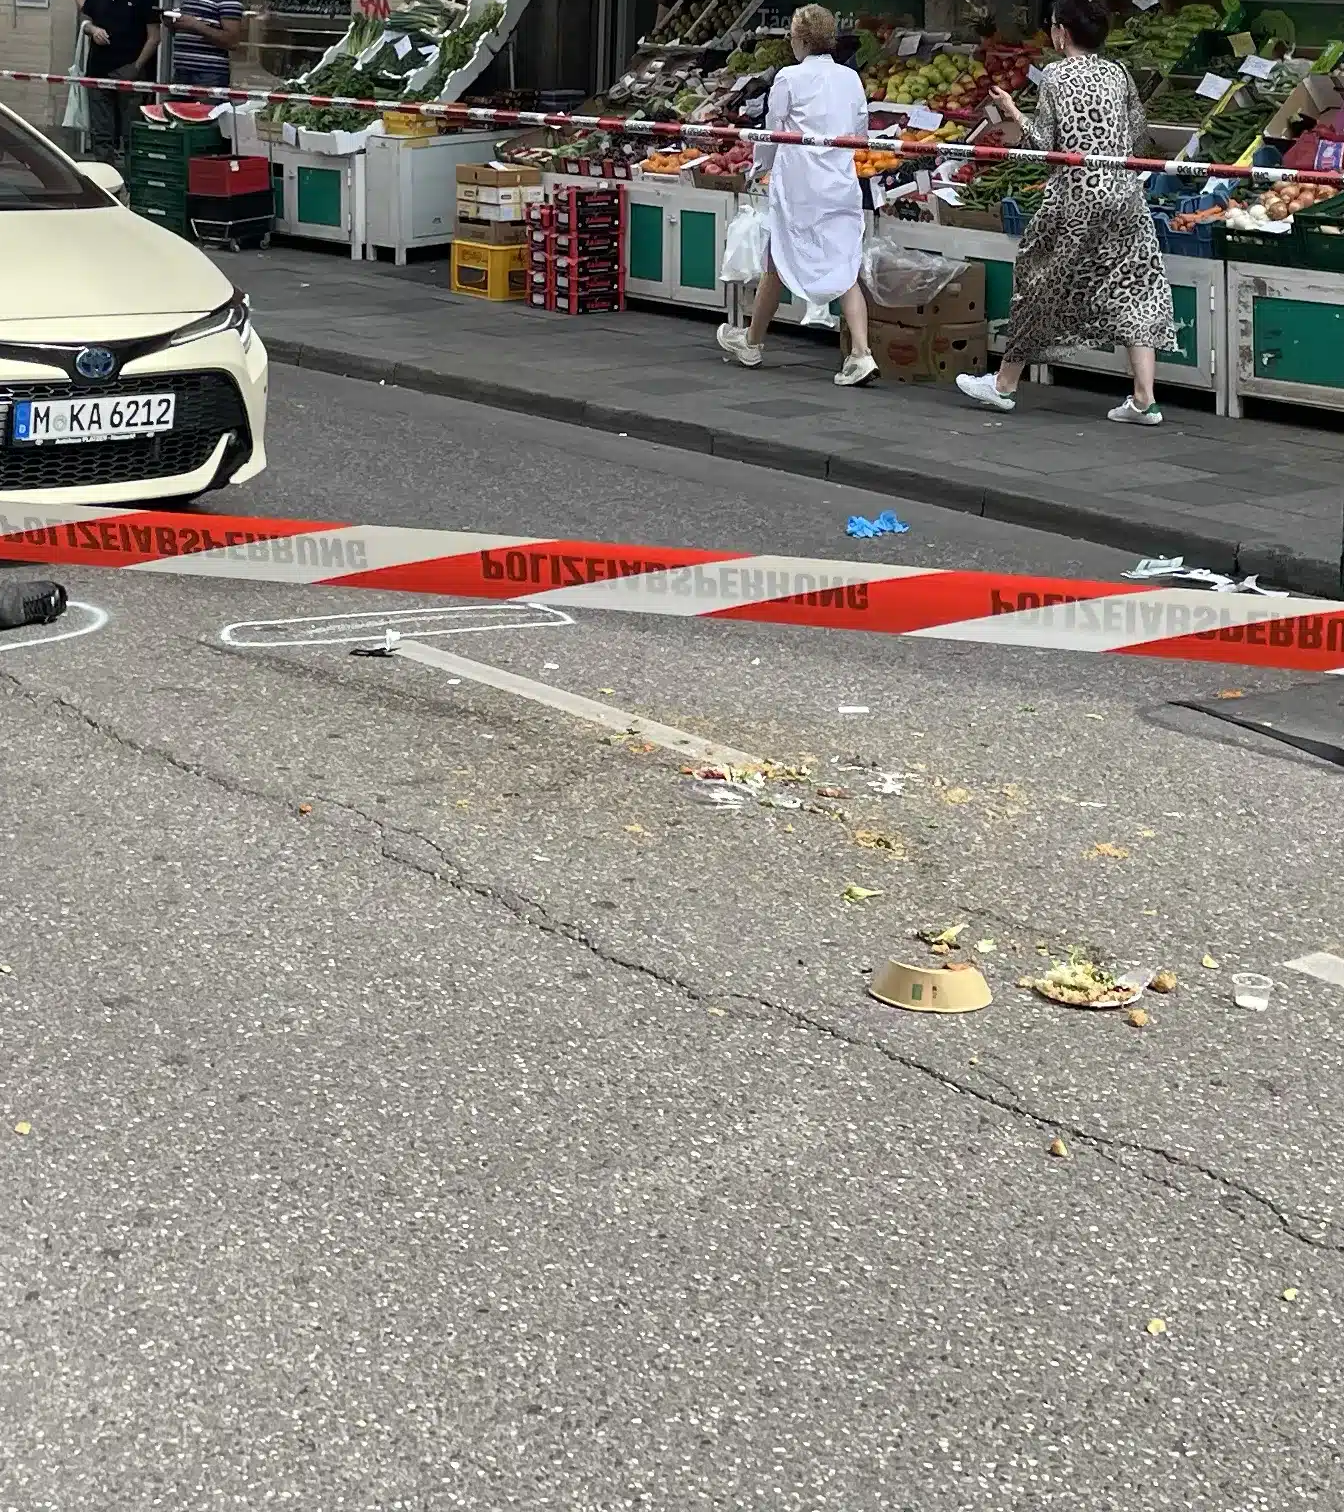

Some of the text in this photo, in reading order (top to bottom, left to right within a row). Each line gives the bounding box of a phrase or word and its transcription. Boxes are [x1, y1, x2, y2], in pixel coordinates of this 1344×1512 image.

[32, 405, 51, 434] M
[69, 403, 102, 432] KA
[109, 398, 171, 428] 6212
